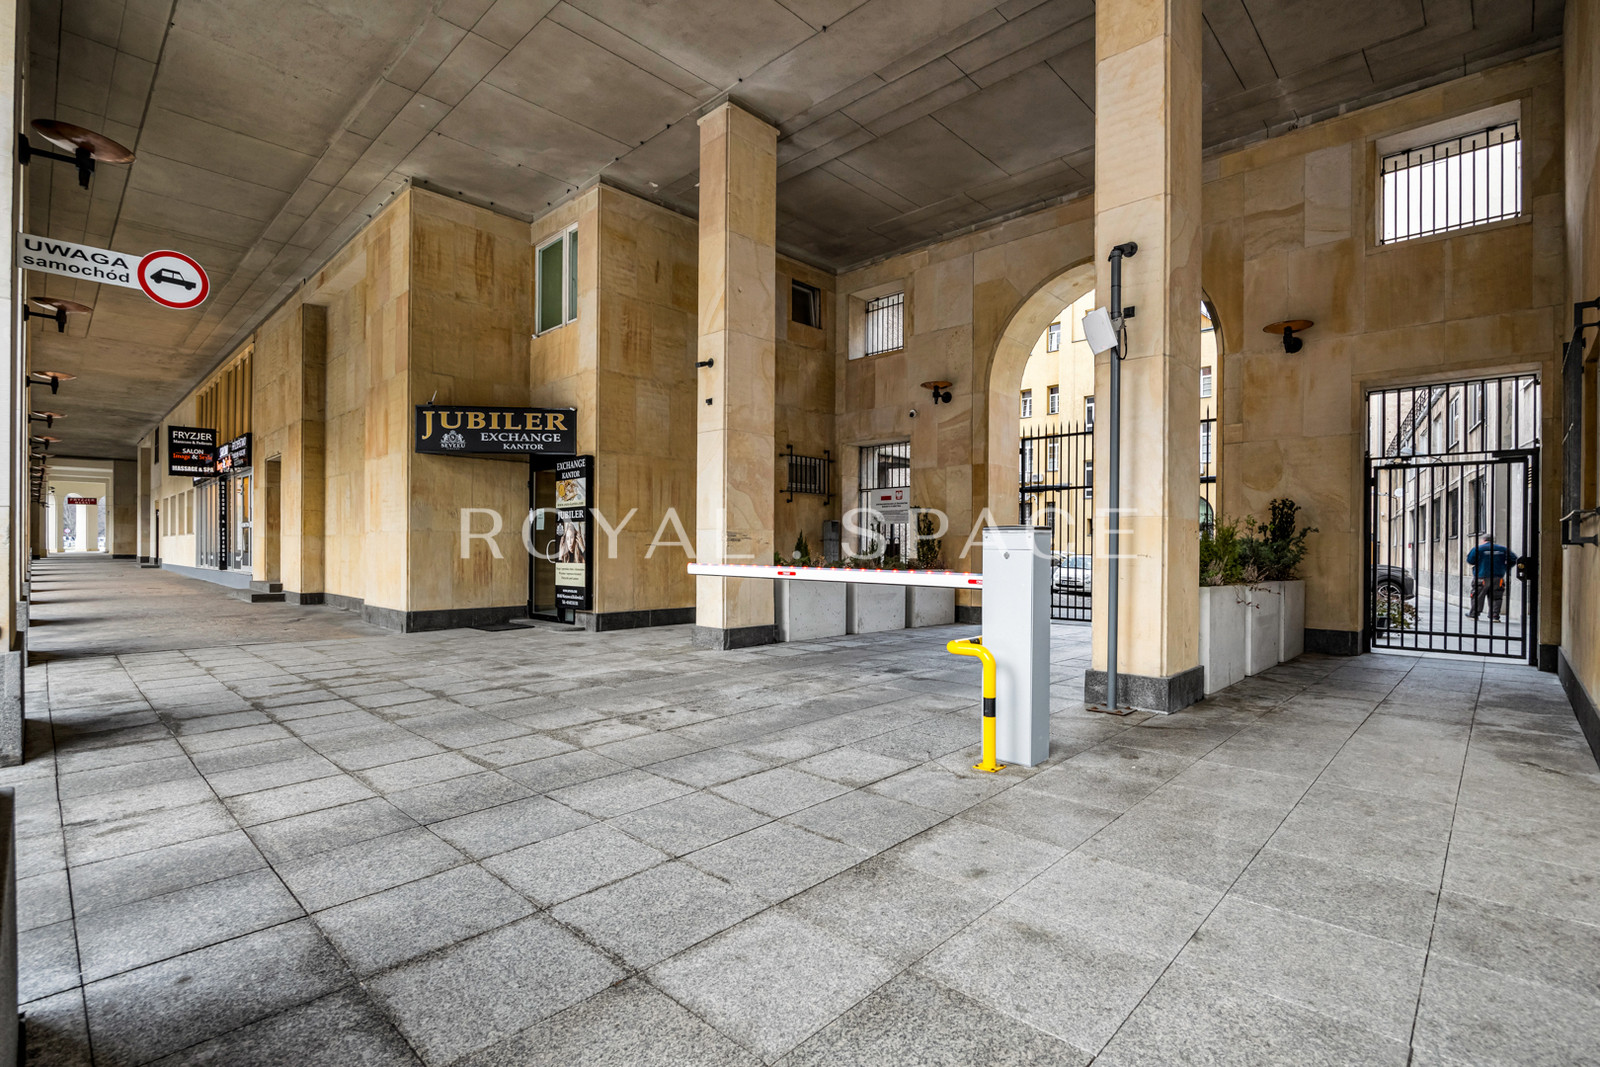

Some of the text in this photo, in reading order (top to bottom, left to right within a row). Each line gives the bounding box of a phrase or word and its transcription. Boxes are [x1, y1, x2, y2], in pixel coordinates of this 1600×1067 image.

[24, 238, 129, 270] UWAGA
[22, 254, 130, 284] samochód
[421, 410, 568, 440] JUBILER
[172, 430, 213, 441] FRYZJER
[480, 432, 561, 443] EXCHANGE
[502, 442, 544, 451] KANTOR
[173, 453, 191, 461] Image
[556, 458, 586, 471] EXCHANGE
[561, 470, 581, 480] KANTOR
[557, 509, 585, 522] JUBILER
